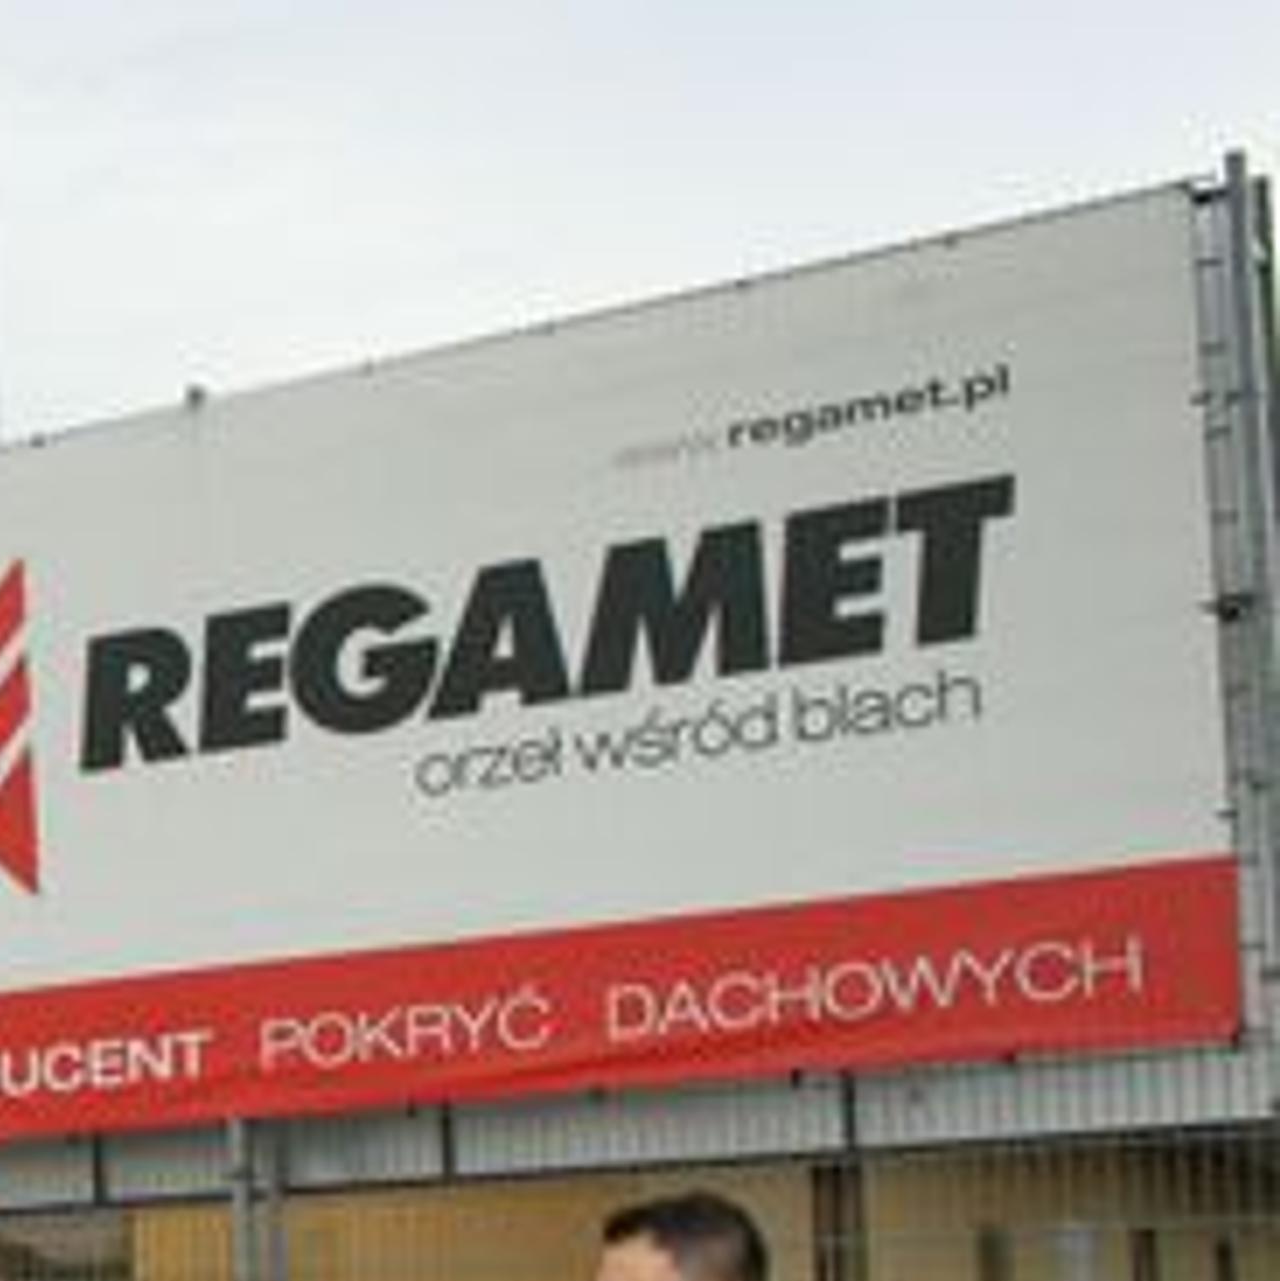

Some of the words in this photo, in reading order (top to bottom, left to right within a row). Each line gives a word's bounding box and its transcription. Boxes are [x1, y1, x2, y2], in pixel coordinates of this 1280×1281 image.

[79, 474, 1017, 773] REGAMET
[415, 727, 563, 796] orzeł
[575, 697, 778, 770] wśród
[791, 669, 982, 743] blach
[258, 983, 549, 1070] POKRYĆ
[606, 934, 1142, 1041] DACHOWYCH
